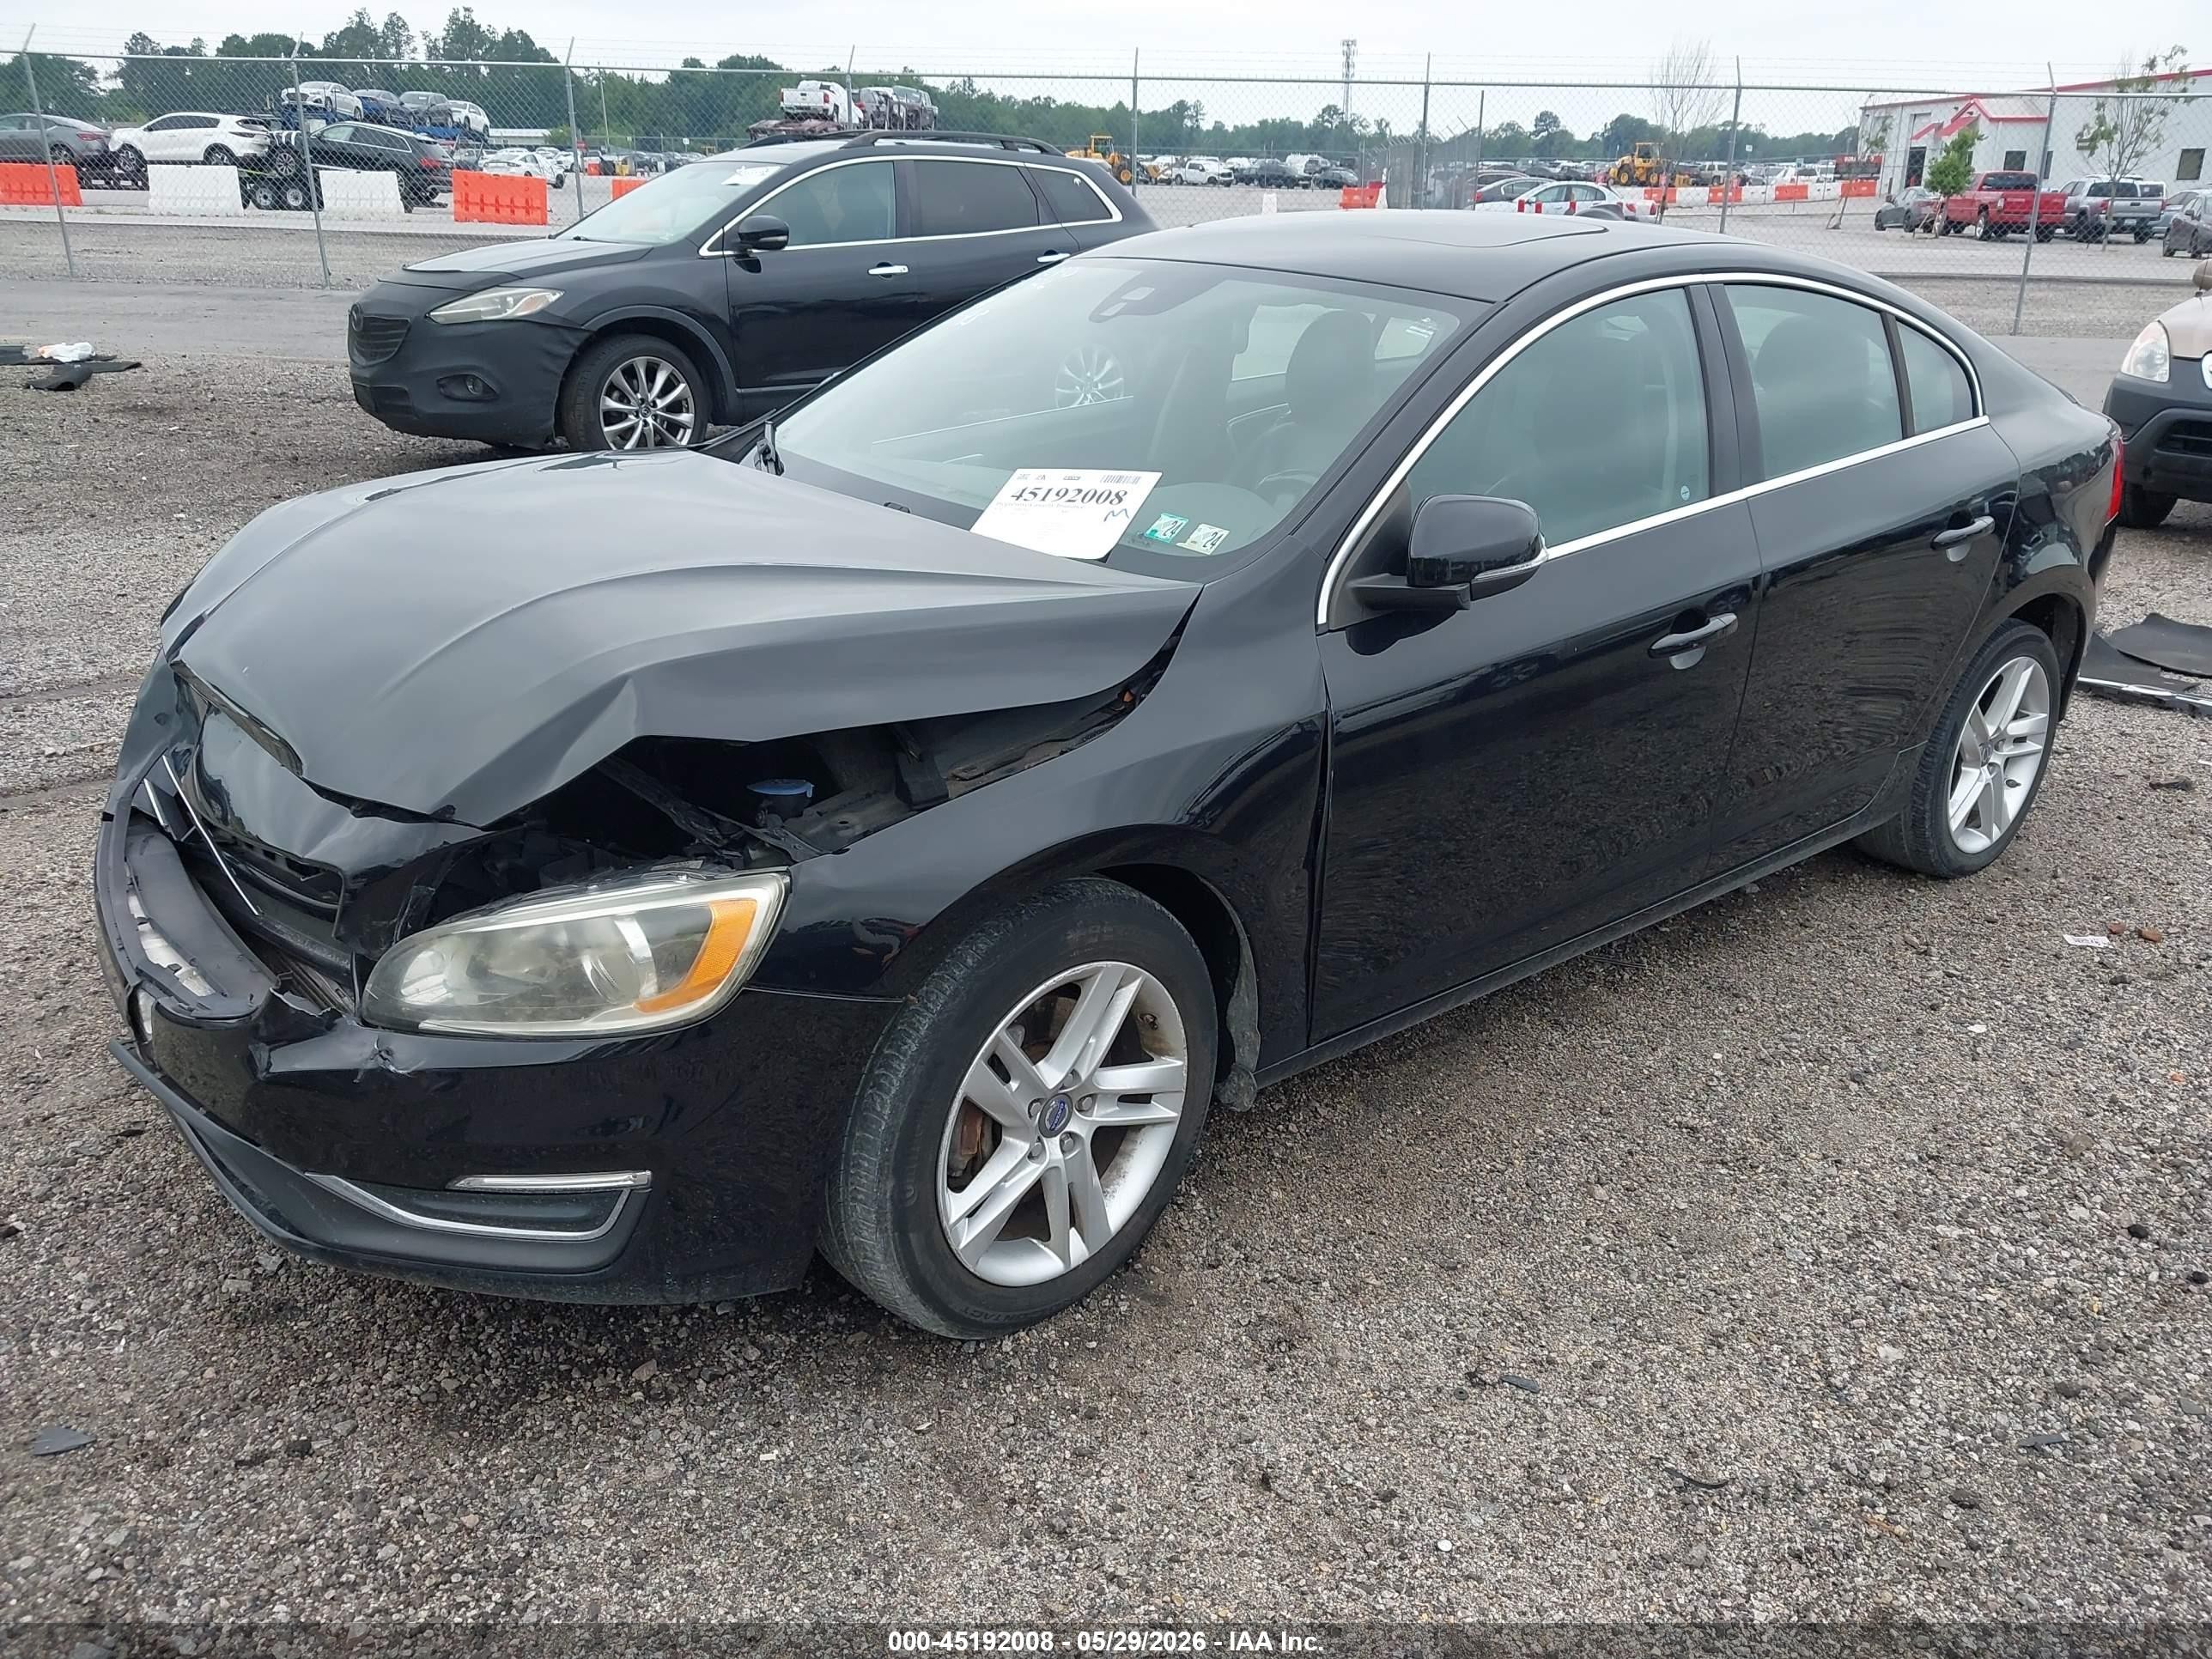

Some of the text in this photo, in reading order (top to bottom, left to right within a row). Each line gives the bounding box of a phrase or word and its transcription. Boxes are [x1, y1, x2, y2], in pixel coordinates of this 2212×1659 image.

[1011, 487, 1128, 507] 45192008
[1163, 520, 1183, 538] 24
[1202, 532, 1224, 550] 24
